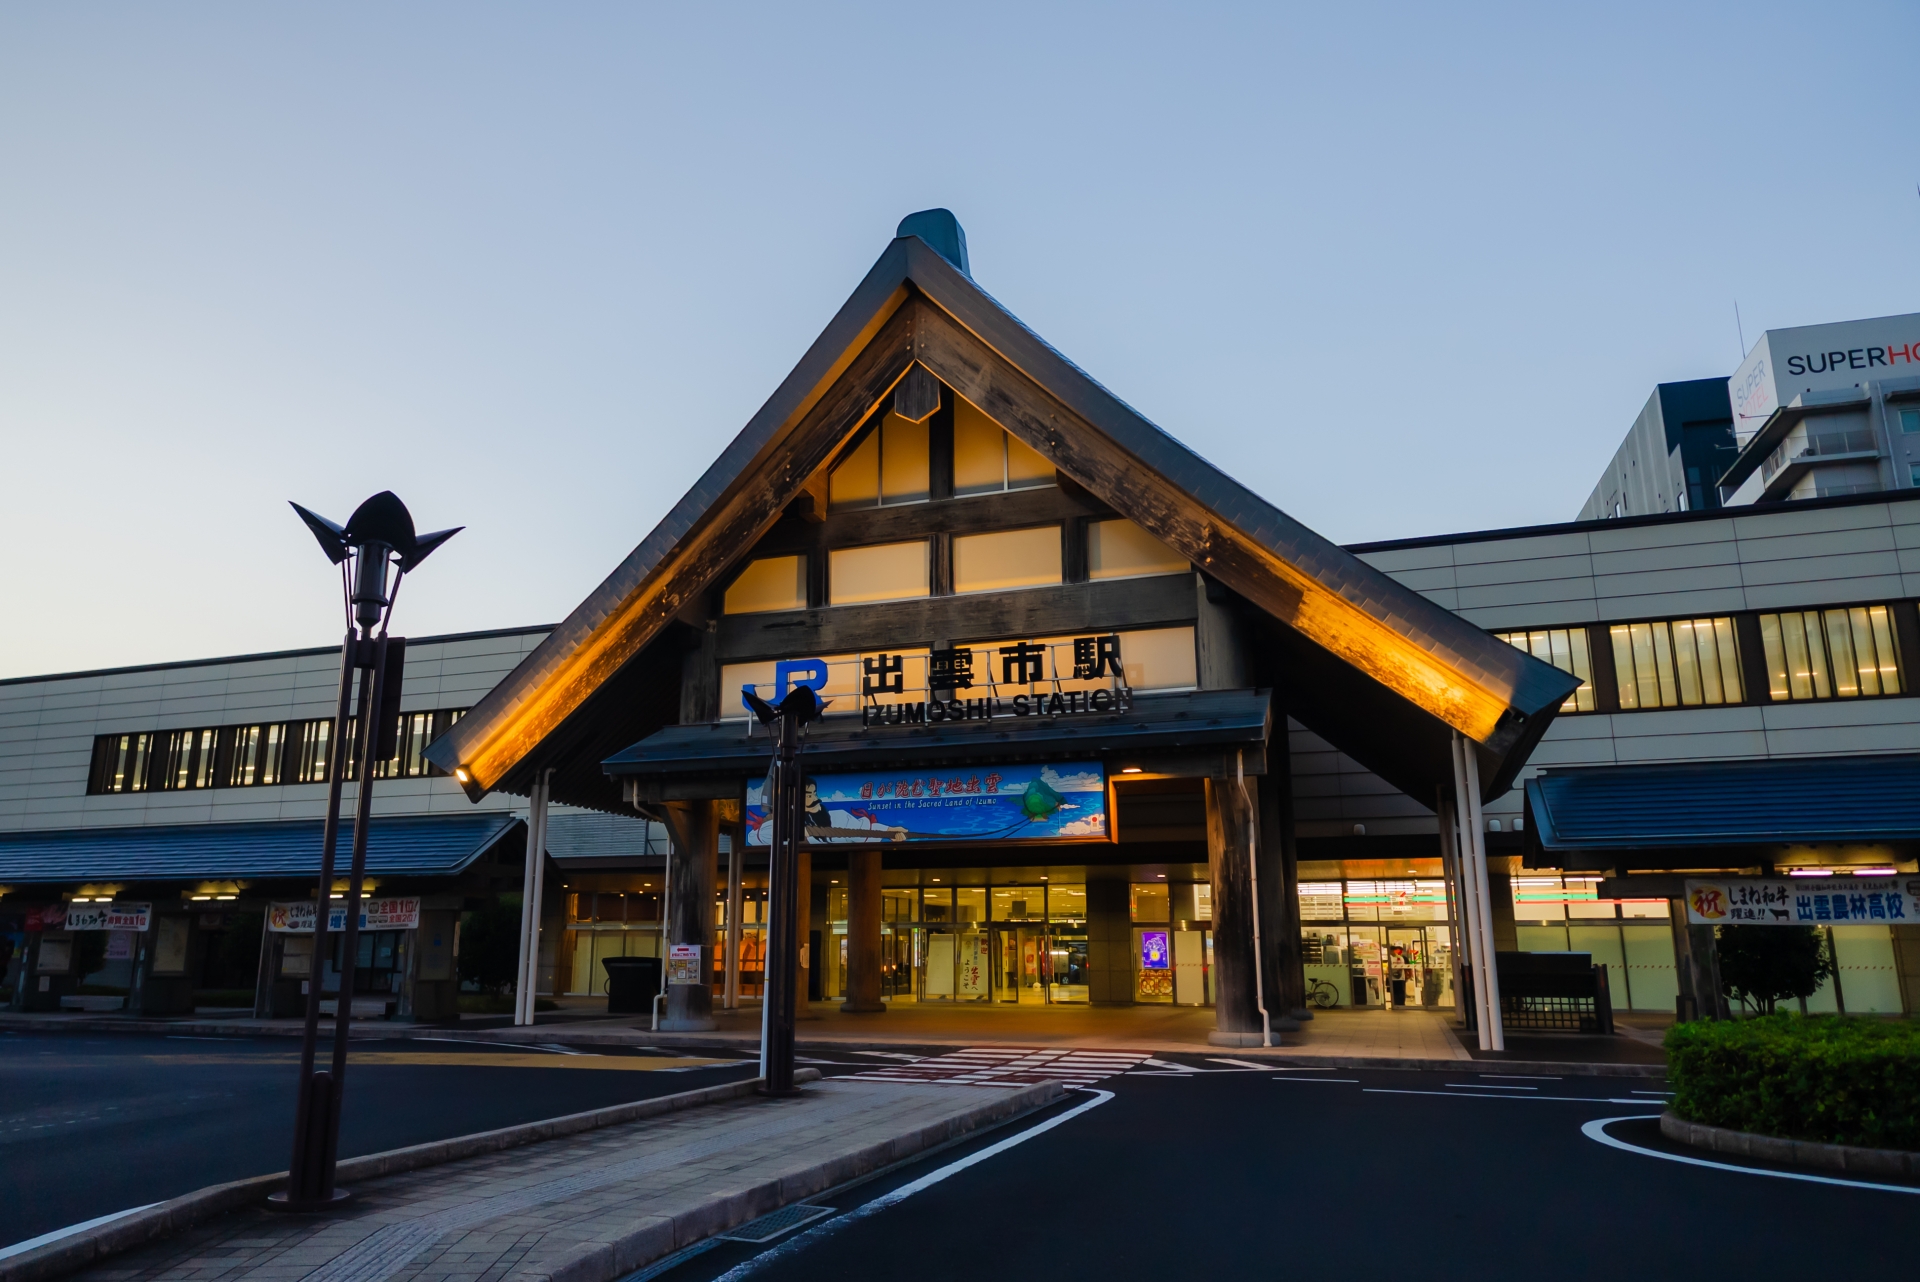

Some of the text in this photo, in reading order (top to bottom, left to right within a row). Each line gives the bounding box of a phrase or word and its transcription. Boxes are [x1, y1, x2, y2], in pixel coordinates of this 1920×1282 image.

[1736, 359, 1766, 408] SUPER
[1740, 383, 1769, 429] HOTEL
[862, 634, 1123, 696] 出雲市駅
[742, 659, 828, 712] JR
[862, 687, 1133, 726] IZUMOSHI STATION
[861, 772, 1003, 799] 日が沈む聖地出雲
[868, 802, 892, 811] Sunset
[904, 801, 915, 809] the
[918, 799, 942, 808] Sacred
[945, 798, 963, 807] Land
[965, 798, 973, 807] of
[976, 797, 997, 805] Izumo
[1695, 890, 1727, 917] 祝
[1728, 885, 1790, 906] しまね和牛
[1796, 892, 1906, 920] 出雲農林高校
[273, 907, 287, 928] 祝
